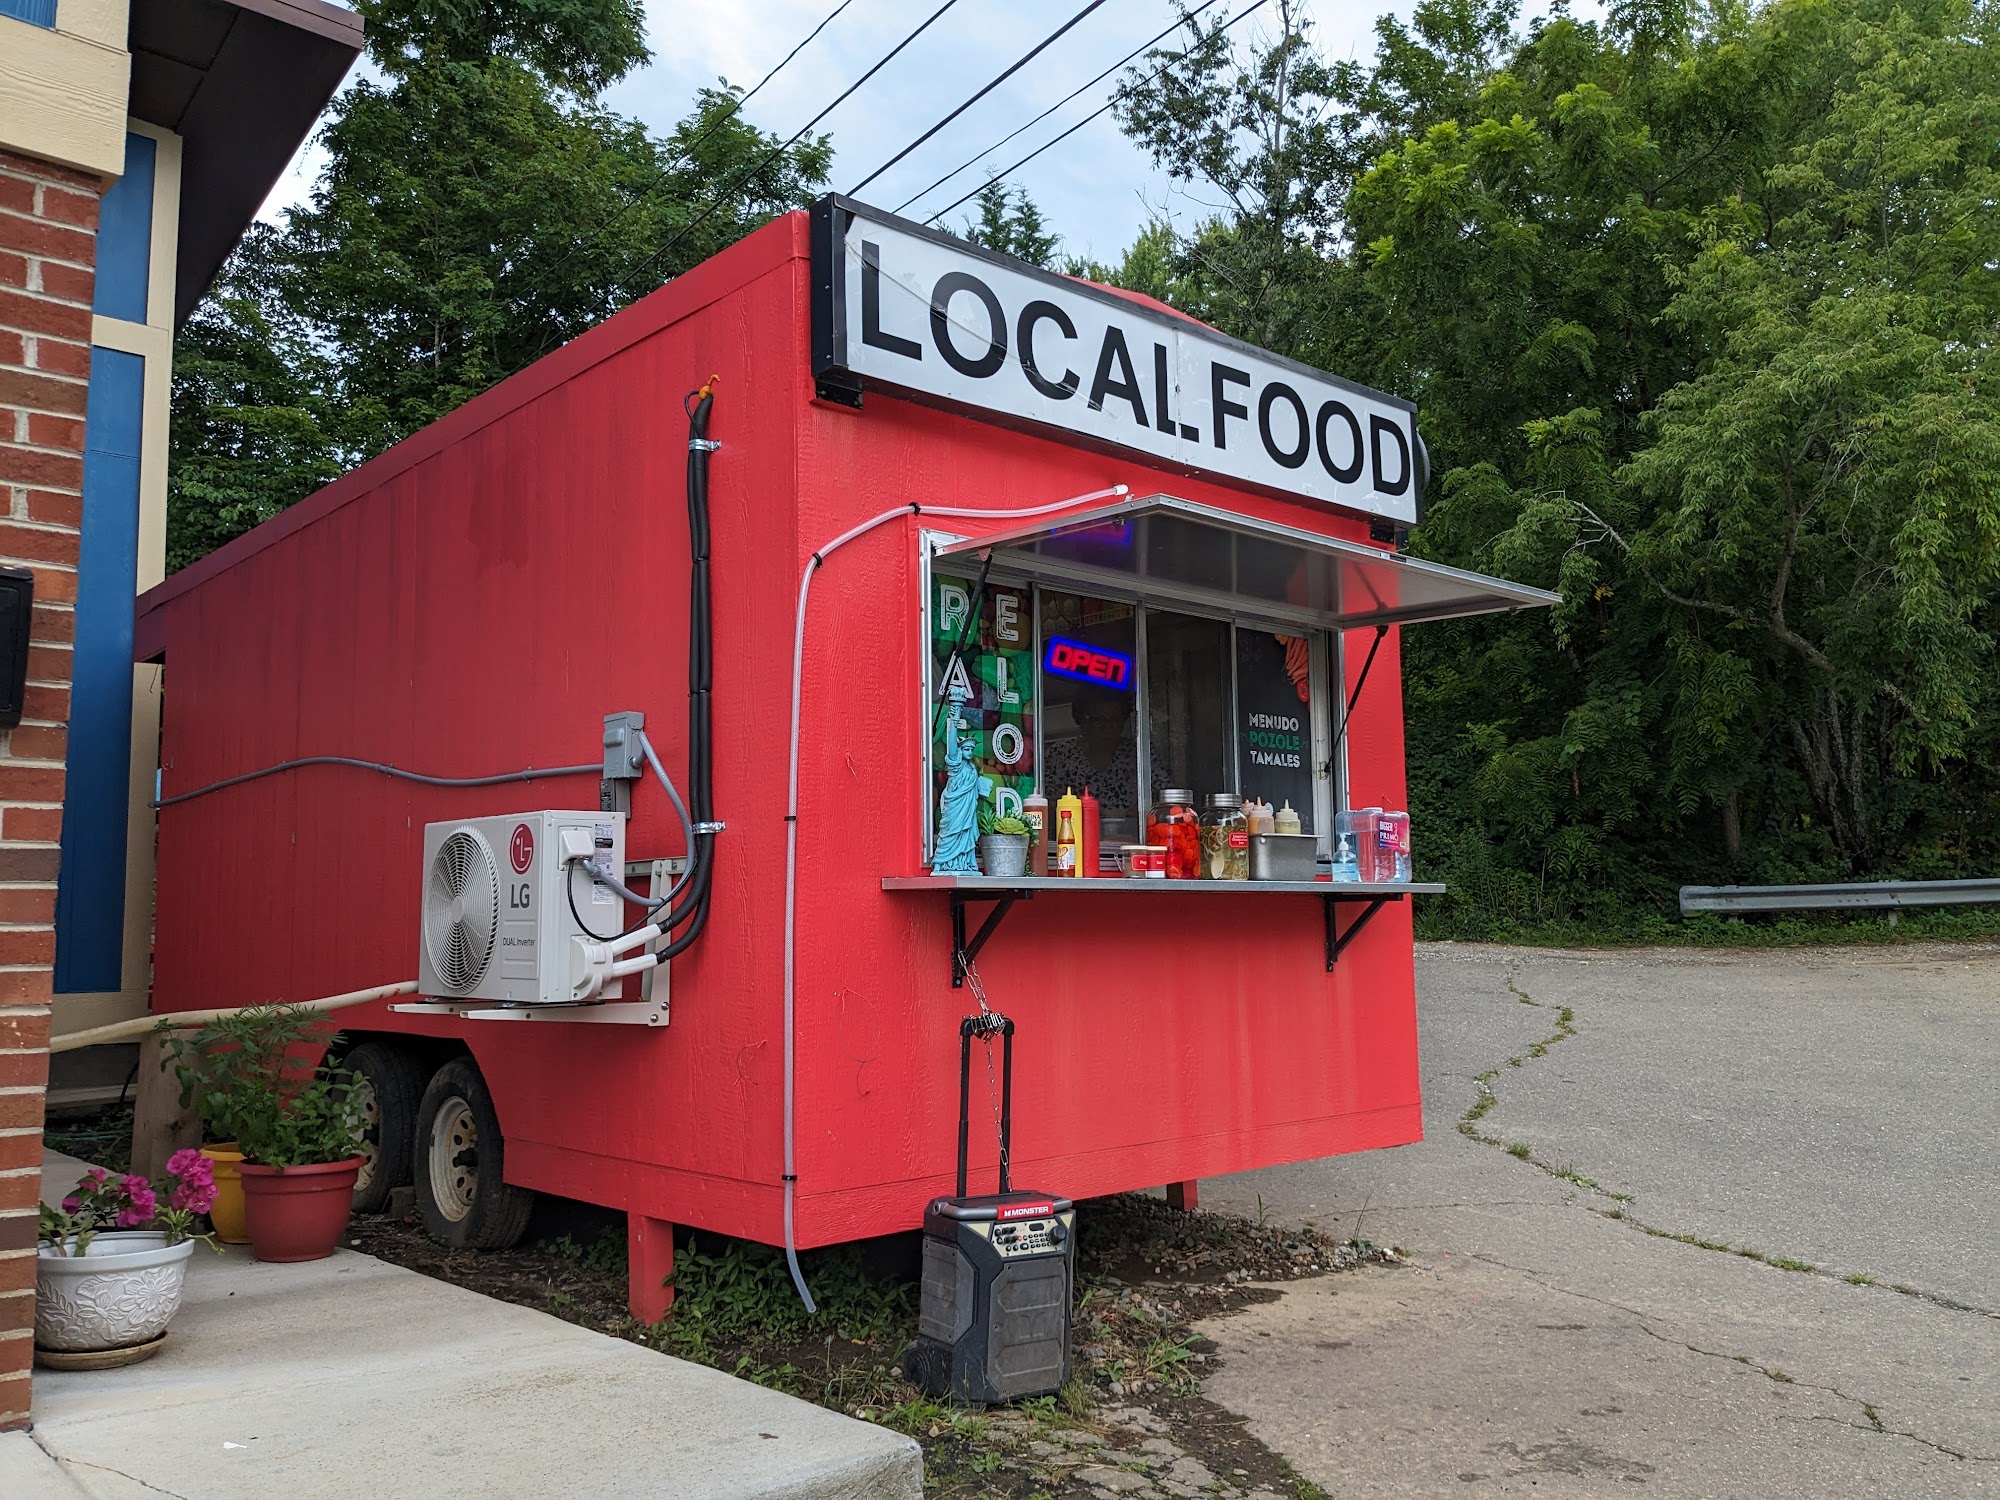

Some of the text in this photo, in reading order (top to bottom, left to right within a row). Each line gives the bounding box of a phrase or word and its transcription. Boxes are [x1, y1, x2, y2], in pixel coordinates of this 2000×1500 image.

[861, 239, 1411, 496] LOCAL FOOD
[1051, 643, 1127, 683] OPEN
[1248, 712, 1299, 732] MENUDO
[1249, 730, 1300, 751] POZOLE
[1249, 750, 1301, 768] TAMALES
[510, 883, 531, 909] LG
[502, 937, 516, 946] DUAL
[1011, 1205, 1049, 1217] MONSTER
